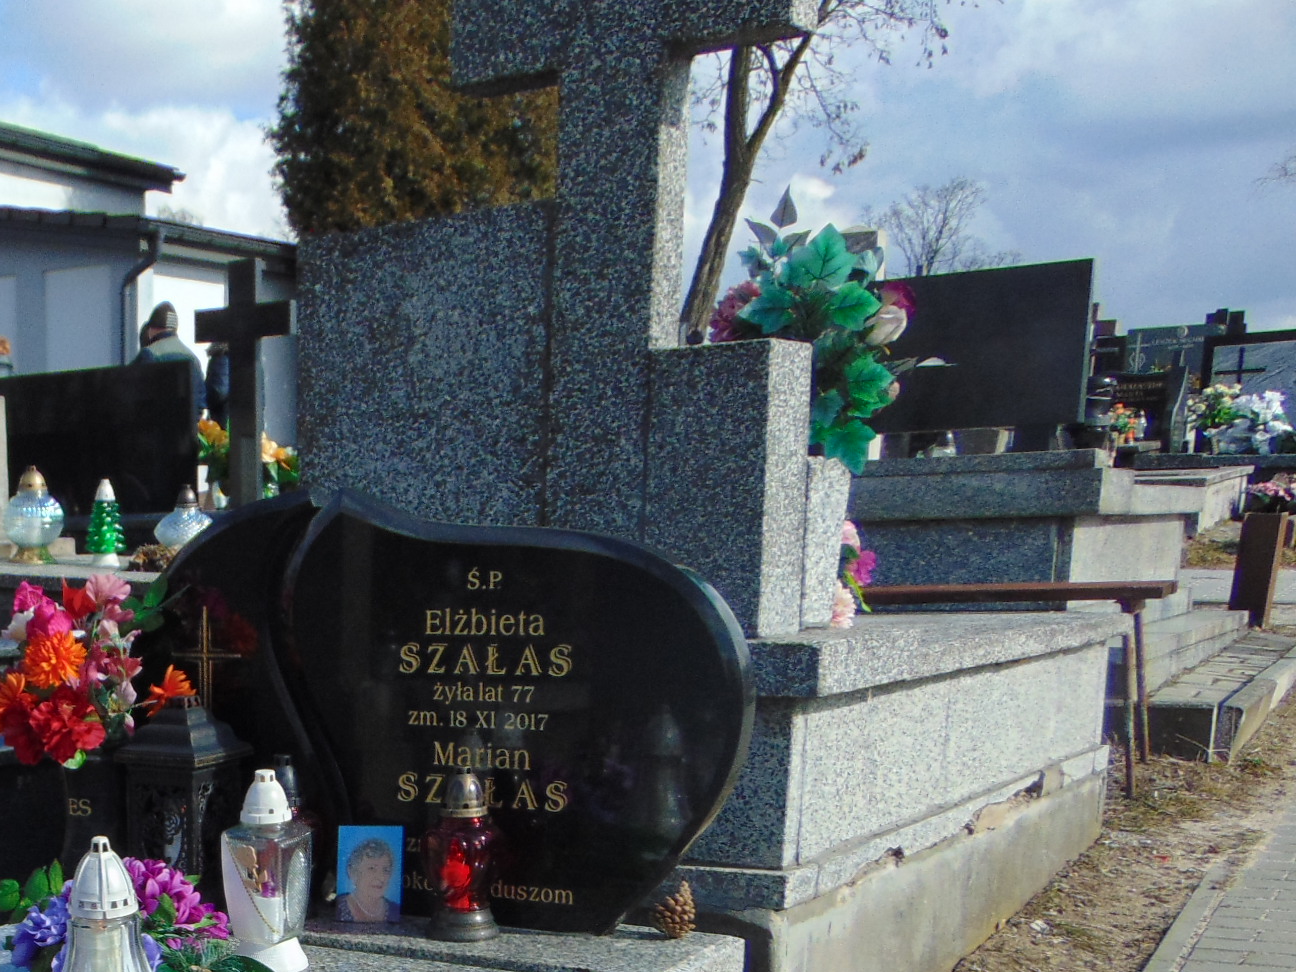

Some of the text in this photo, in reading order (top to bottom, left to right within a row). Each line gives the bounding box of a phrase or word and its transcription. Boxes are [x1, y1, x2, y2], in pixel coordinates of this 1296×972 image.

[424, 607, 545, 636] Elżbieta
[399, 642, 572, 677] SZAŁAS
[433, 682, 535, 705] żyła lat 77
[408, 710, 549, 731] zm. 18 XI 2017
[433, 741, 532, 771] Marian
[397, 771, 569, 813] SZŁAS
[490, 880, 574, 905] duszom
